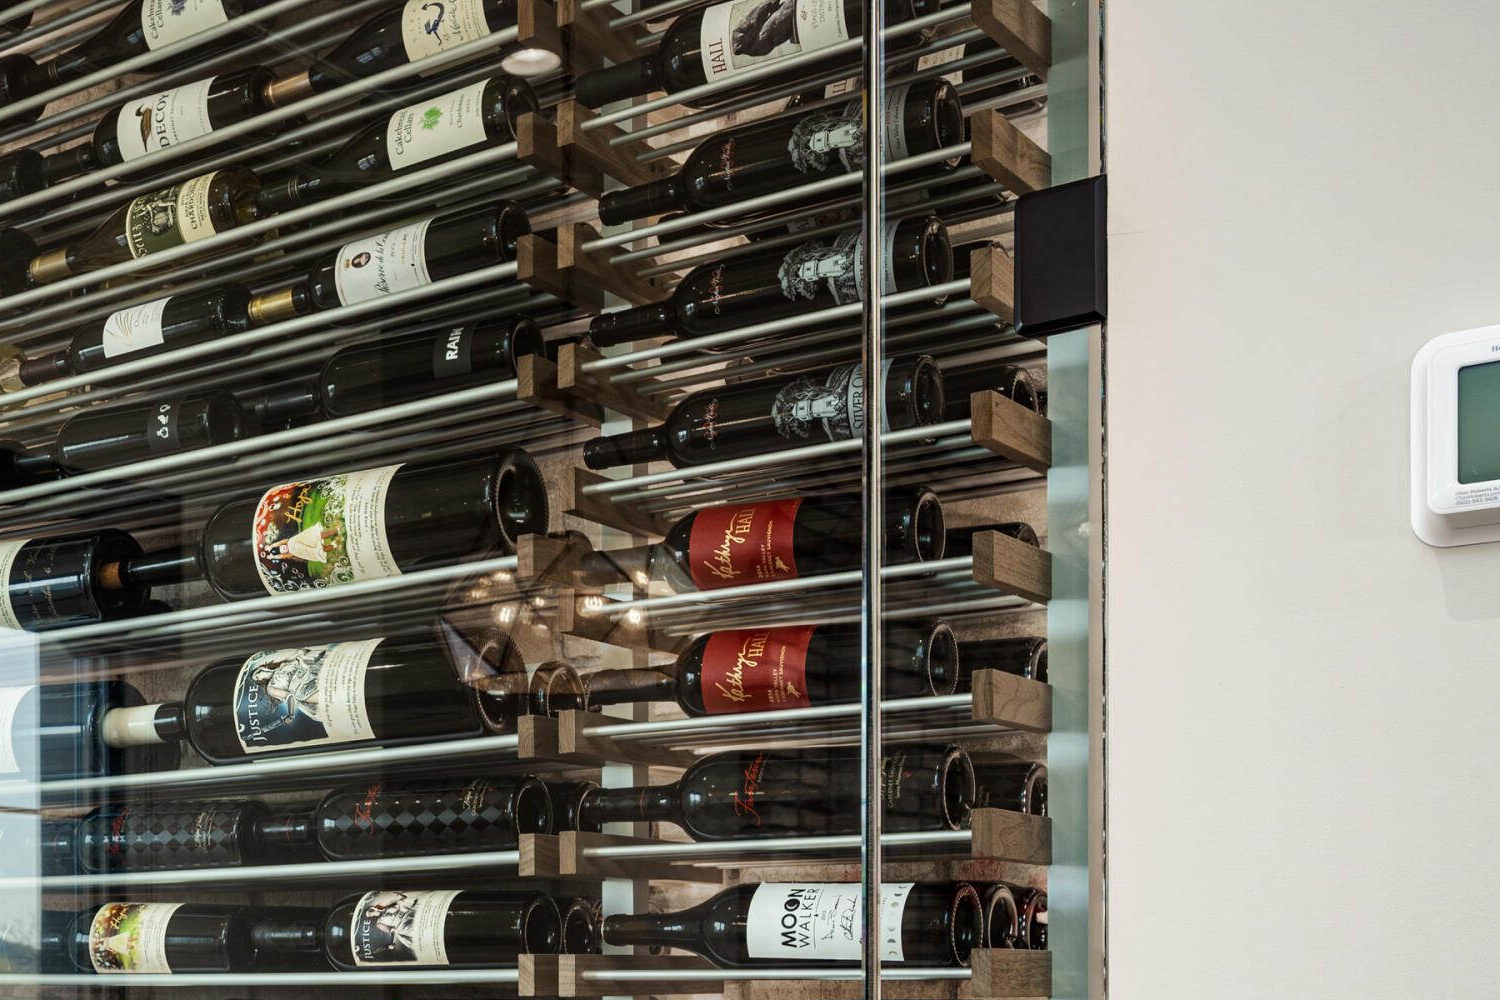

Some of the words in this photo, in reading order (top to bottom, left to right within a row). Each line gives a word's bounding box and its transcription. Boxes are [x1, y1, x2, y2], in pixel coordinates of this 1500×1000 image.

[709, 37, 727, 75] HALL
[155, 94, 170, 148] DECOY
[285, 484, 313, 524] Hope
[703, 512, 746, 579] Kathryn
[735, 506, 756, 534] HALL
[715, 636, 758, 702] Kathryn
[747, 631, 770, 658] HALL
[248, 685, 267, 741] JUSTICE
[362, 920, 374, 959] JUSTICE
[781, 888, 806, 948] MOON
[799, 888, 820, 948] WALKER
